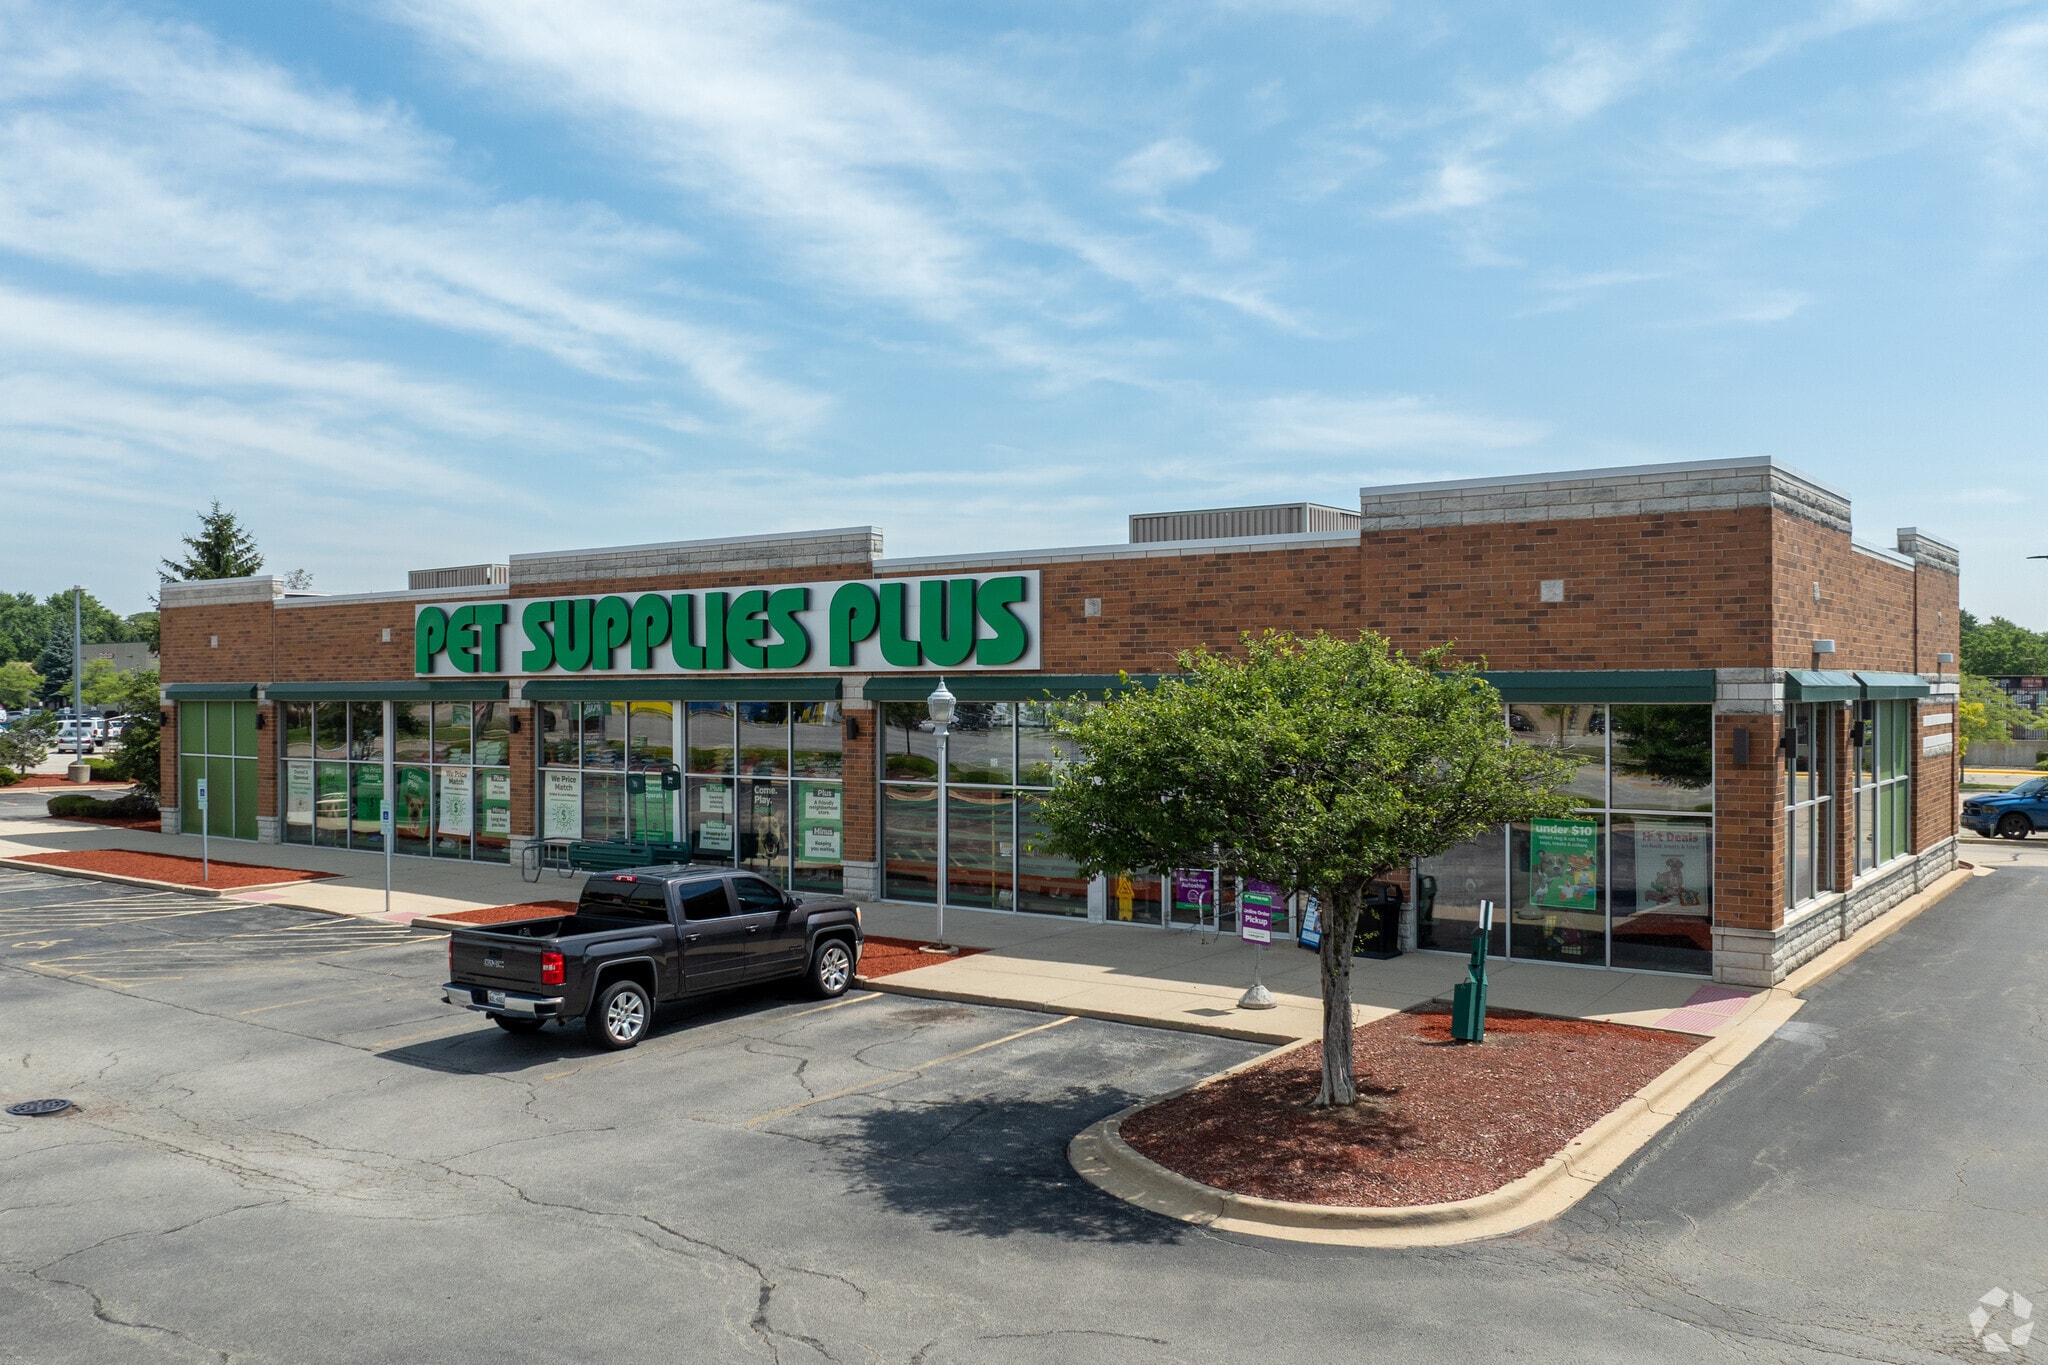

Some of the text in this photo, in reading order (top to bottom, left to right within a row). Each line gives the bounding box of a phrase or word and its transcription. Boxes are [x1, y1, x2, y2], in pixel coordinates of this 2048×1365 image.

[416, 576, 1028, 673] PET SUPPLIES PLUS
[551, 775, 577, 784] We Price
[554, 784, 573, 792] Match
[709, 784, 723, 793] Plus
[754, 785, 778, 795] Come.
[817, 789, 832, 797] Plus
[754, 795, 773, 806] Play.
[813, 827, 833, 836] Minus
[1535, 824, 1593, 837] under $10
[1666, 831, 1699, 843] Deals
[815, 840, 832, 848] Keeping
[1181, 882, 1206, 890] Autoship
[1245, 915, 1269, 927] Pickup
